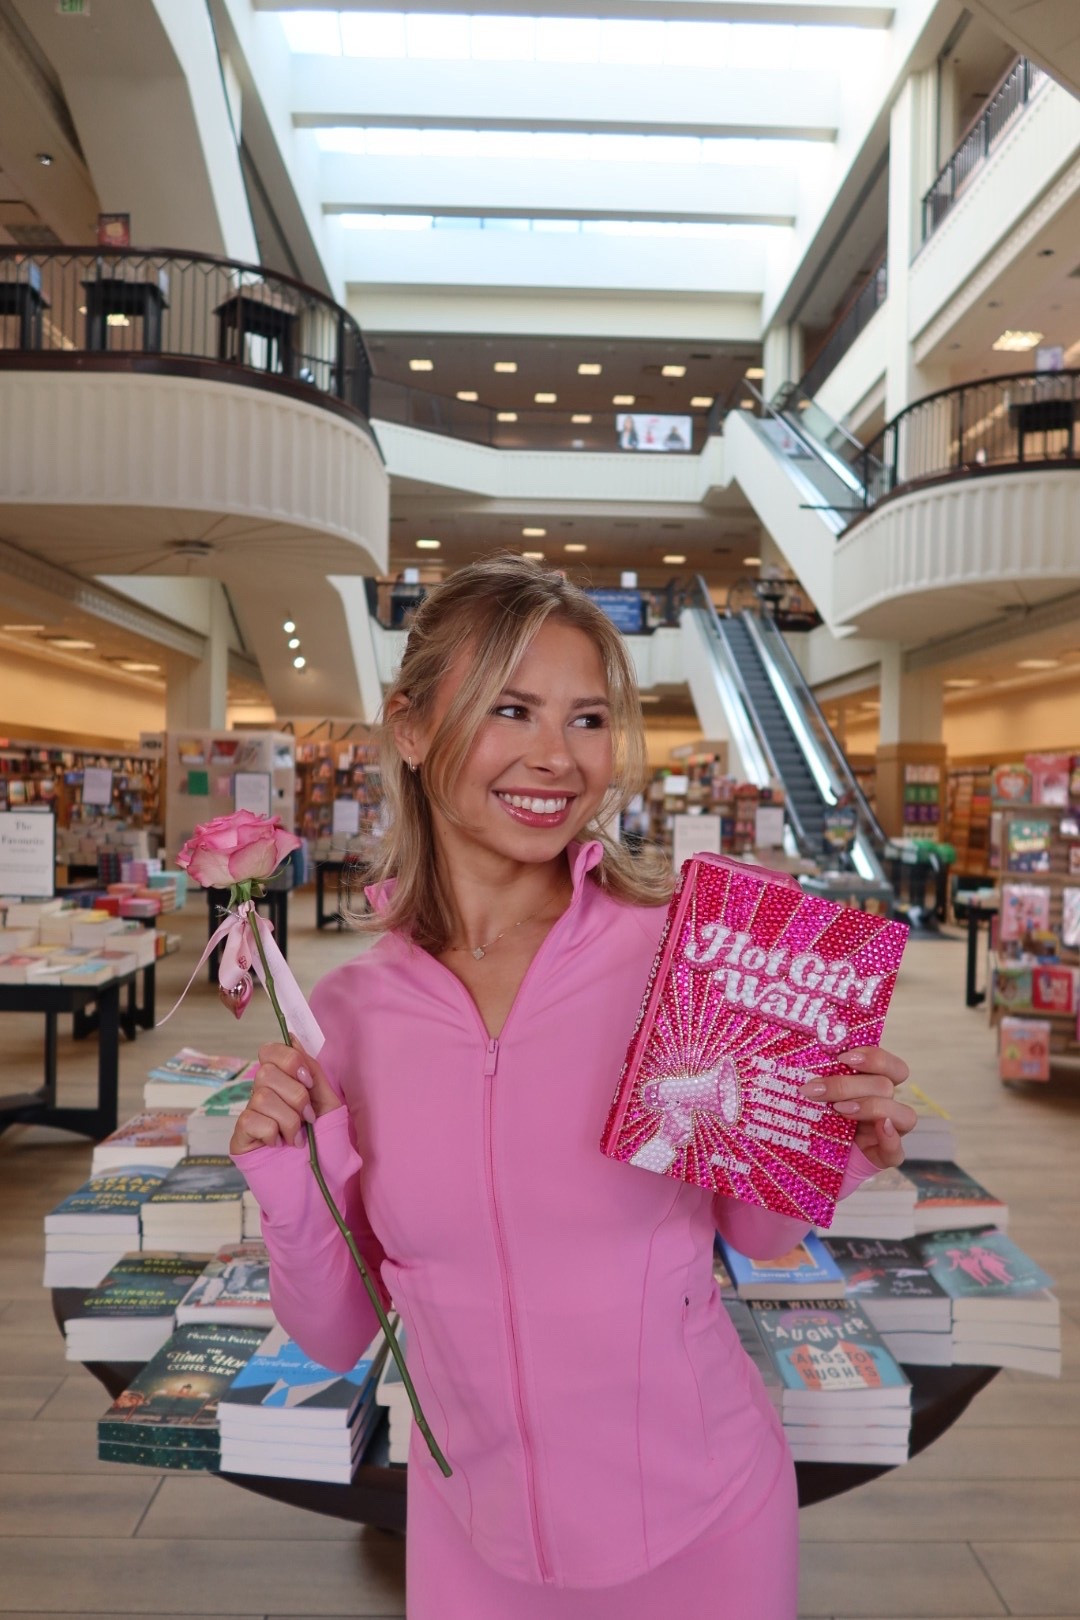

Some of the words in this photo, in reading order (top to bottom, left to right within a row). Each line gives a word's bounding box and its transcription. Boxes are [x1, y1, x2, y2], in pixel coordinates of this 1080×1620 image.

[683, 922, 790, 977] Hot
[790, 951, 884, 1008] Girl
[713, 968, 847, 1047] Walk
[753, 1106, 813, 1138] CULTIVATE
[744, 1122, 813, 1157] CONFIDENCE
[89, 1176, 163, 1187] DREAM
[89, 1184, 153, 1193] STATE
[151, 1193, 203, 1202] RICHARD
[204, 1192, 238, 1201] PRICE
[82, 1298, 180, 1307] CUNNINGHAM
[751, 1299, 782, 1310] NOT
[787, 1299, 858, 1310] WITHOUT
[760, 1317, 869, 1342] LAUGHTER
[186, 1331, 226, 1343] Phaedra
[785, 1350, 880, 1365] LANGSTON
[166, 1363, 208, 1373] COFFEE
[207, 1365, 237, 1377] SHOP
[802, 1365, 879, 1381] HUGHES
